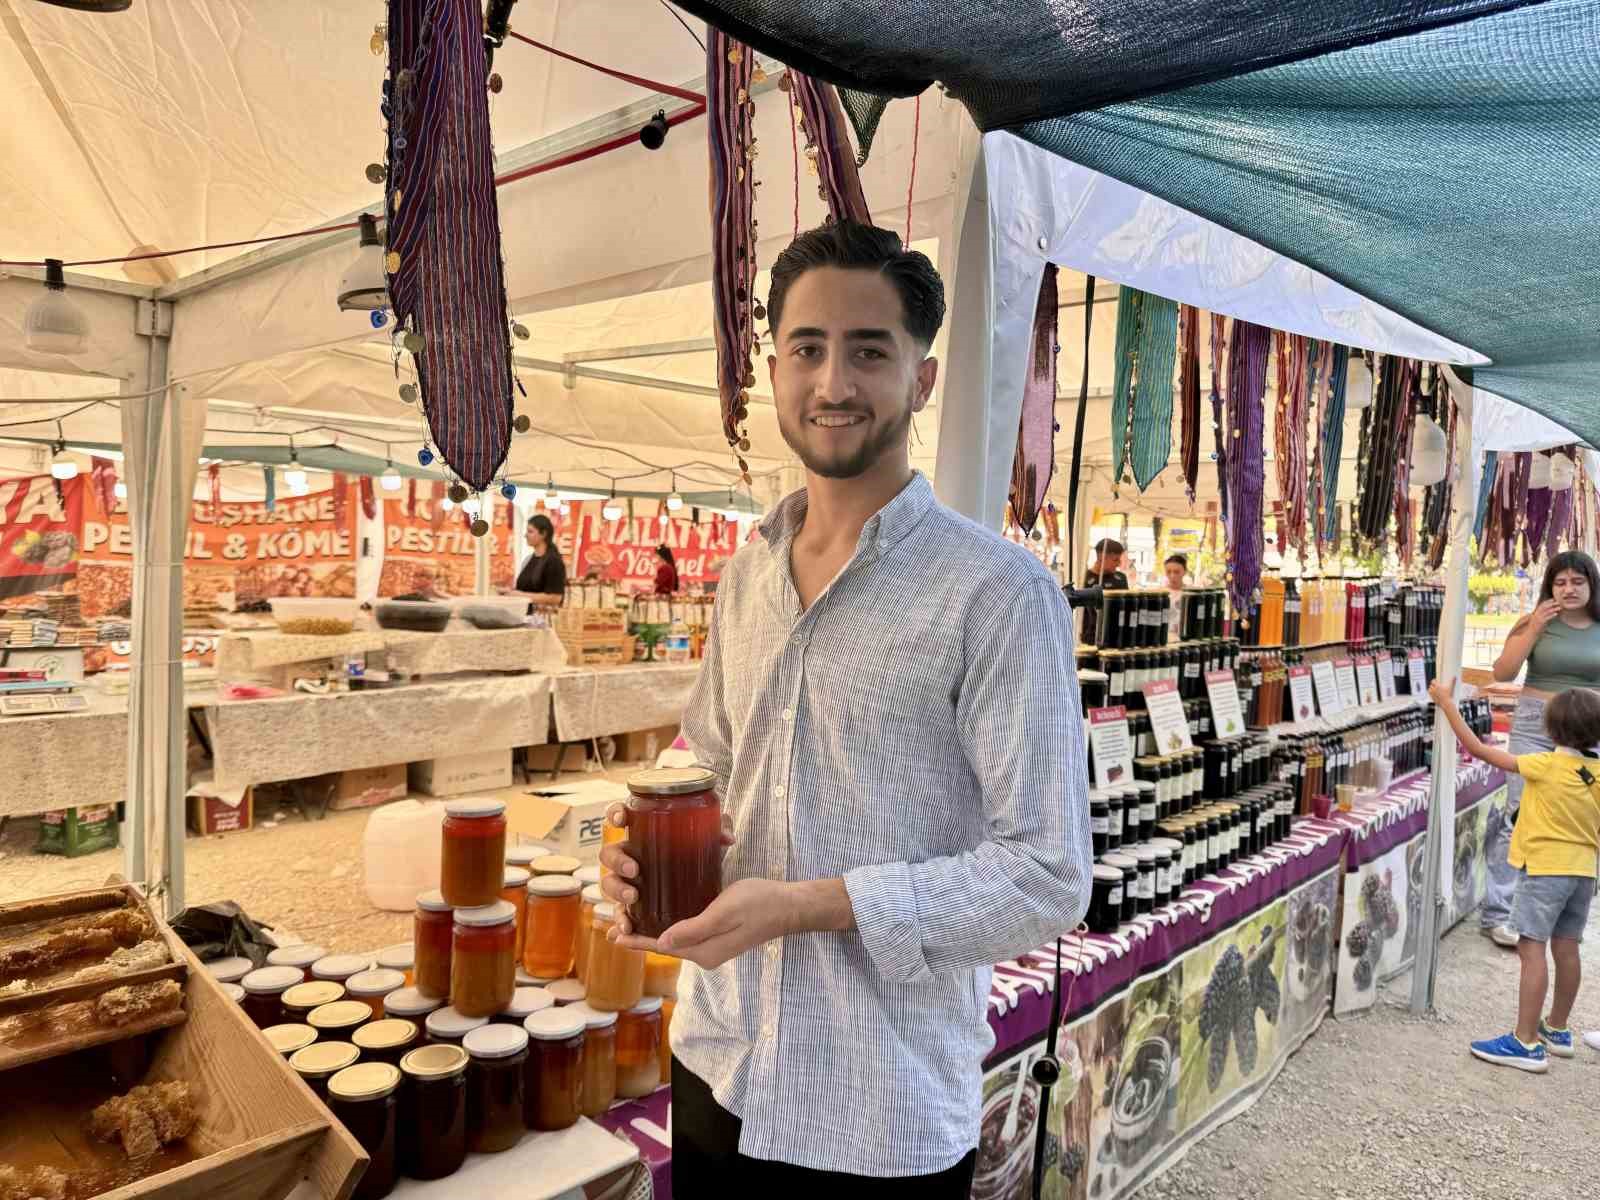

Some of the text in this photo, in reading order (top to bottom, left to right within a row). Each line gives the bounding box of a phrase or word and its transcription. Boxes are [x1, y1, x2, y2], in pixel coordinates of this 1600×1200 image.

[223, 533, 248, 560] &
[256, 527, 351, 560] KÖME
[386, 524, 476, 556] PESTİL
